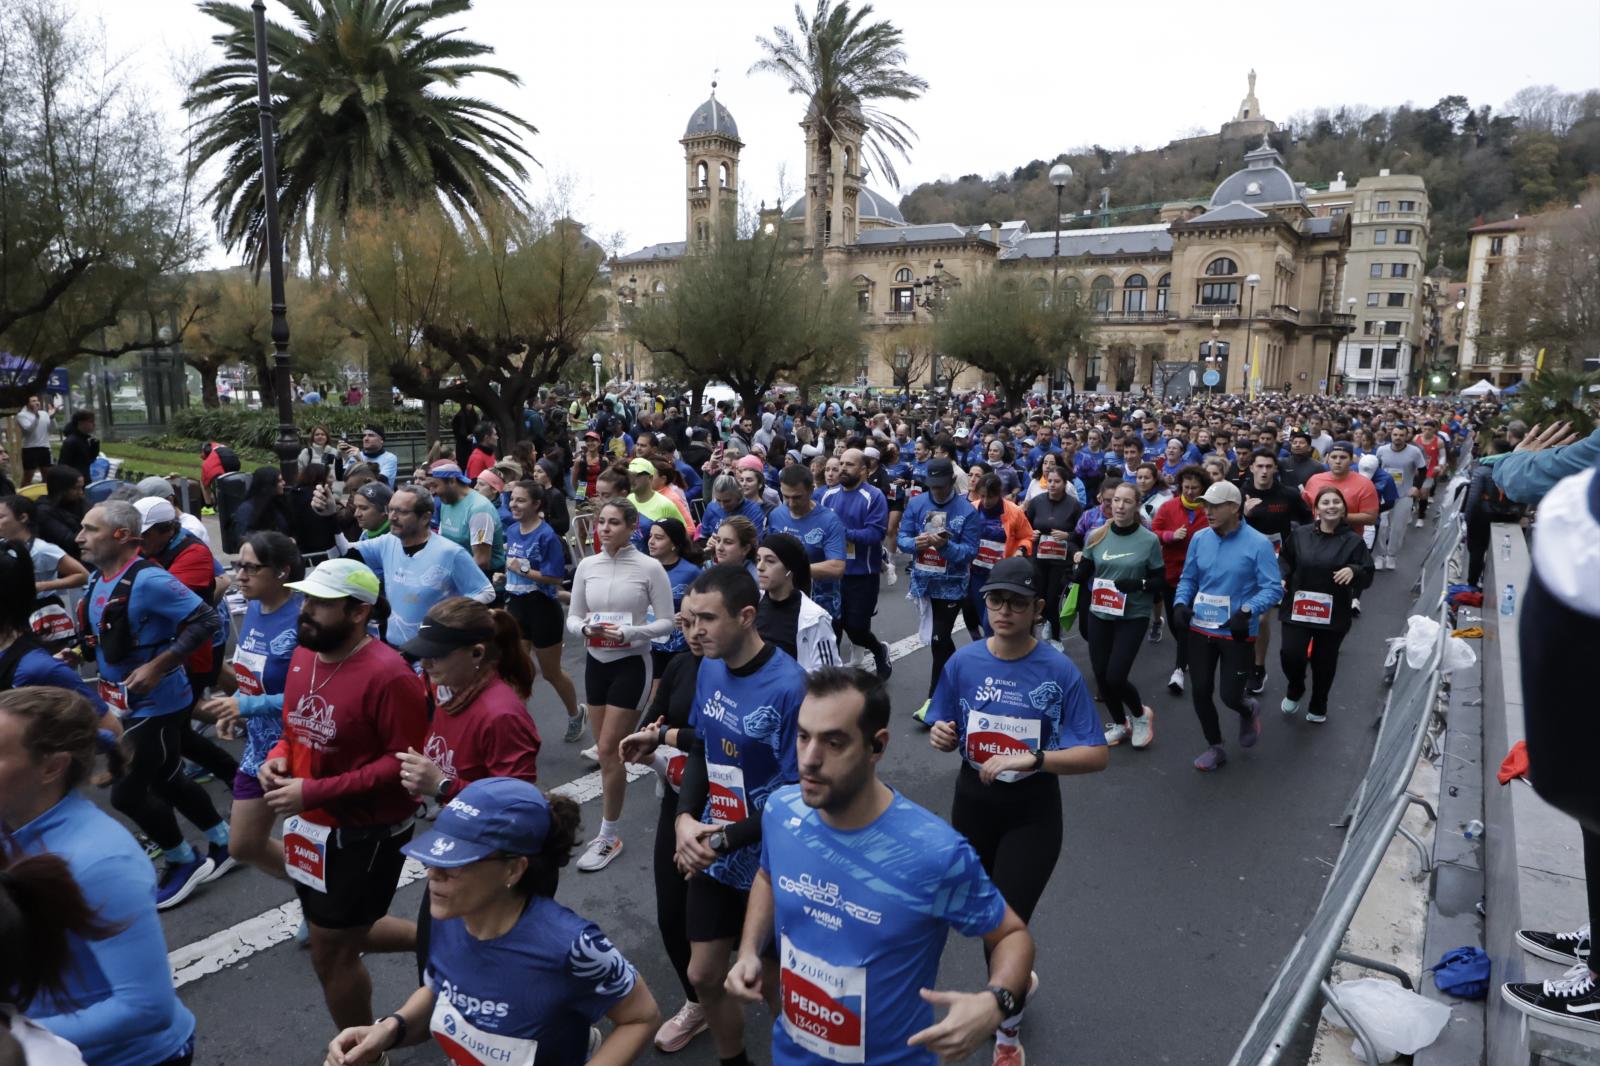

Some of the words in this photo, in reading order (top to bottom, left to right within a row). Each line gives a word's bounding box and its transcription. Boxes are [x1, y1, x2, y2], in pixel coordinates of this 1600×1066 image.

[1303, 604, 1325, 612] LAURA
[994, 679, 1017, 687] ZURICH
[993, 722, 1028, 734] ZURICH
[979, 742, 1030, 756] MÉLANI
[294, 844, 320, 864] XAVIER
[799, 873, 839, 896] CLUB
[810, 908, 843, 928] AMBAR
[799, 962, 844, 989] ZURICH
[790, 990, 845, 1026] PEDRO
[794, 1012, 829, 1039] 13402
[460, 1031, 512, 1063] ZURICH
